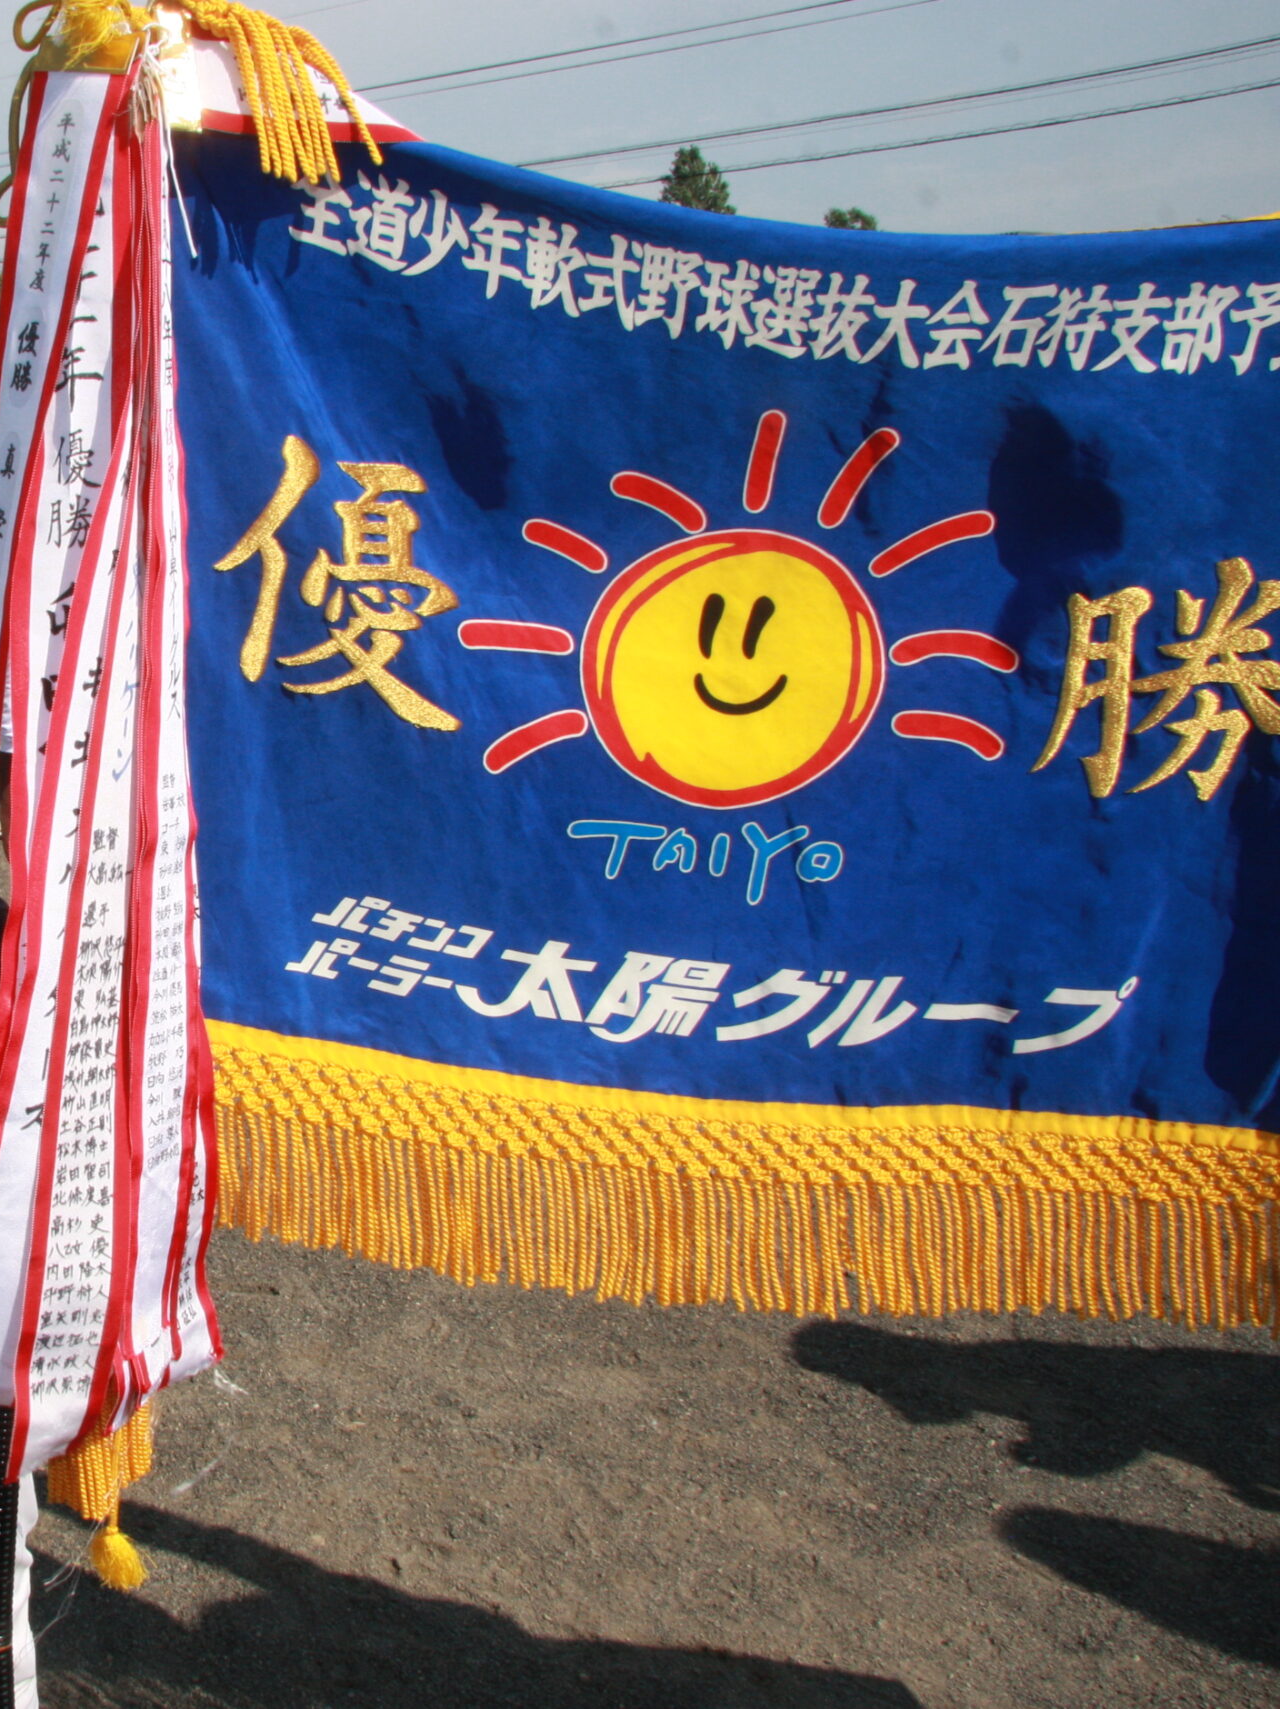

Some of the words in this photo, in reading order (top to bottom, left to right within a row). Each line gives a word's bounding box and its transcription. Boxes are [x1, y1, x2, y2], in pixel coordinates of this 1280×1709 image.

[30, 112, 75, 292] 平成二十二年度
[289, 170, 1280, 377] 全道少年軟式野球選抜大会石狩支部予
[10, 321, 40, 392] 優勝
[46, 428, 102, 549] 優勝
[212, 433, 462, 732] 優
[1028, 556, 1280, 802] 勝
[567, 820, 844, 906] TAIYO
[285, 938, 452, 997] パーラー
[312, 896, 494, 959] パチンコ
[455, 940, 1139, 1054] 太陽グループ
